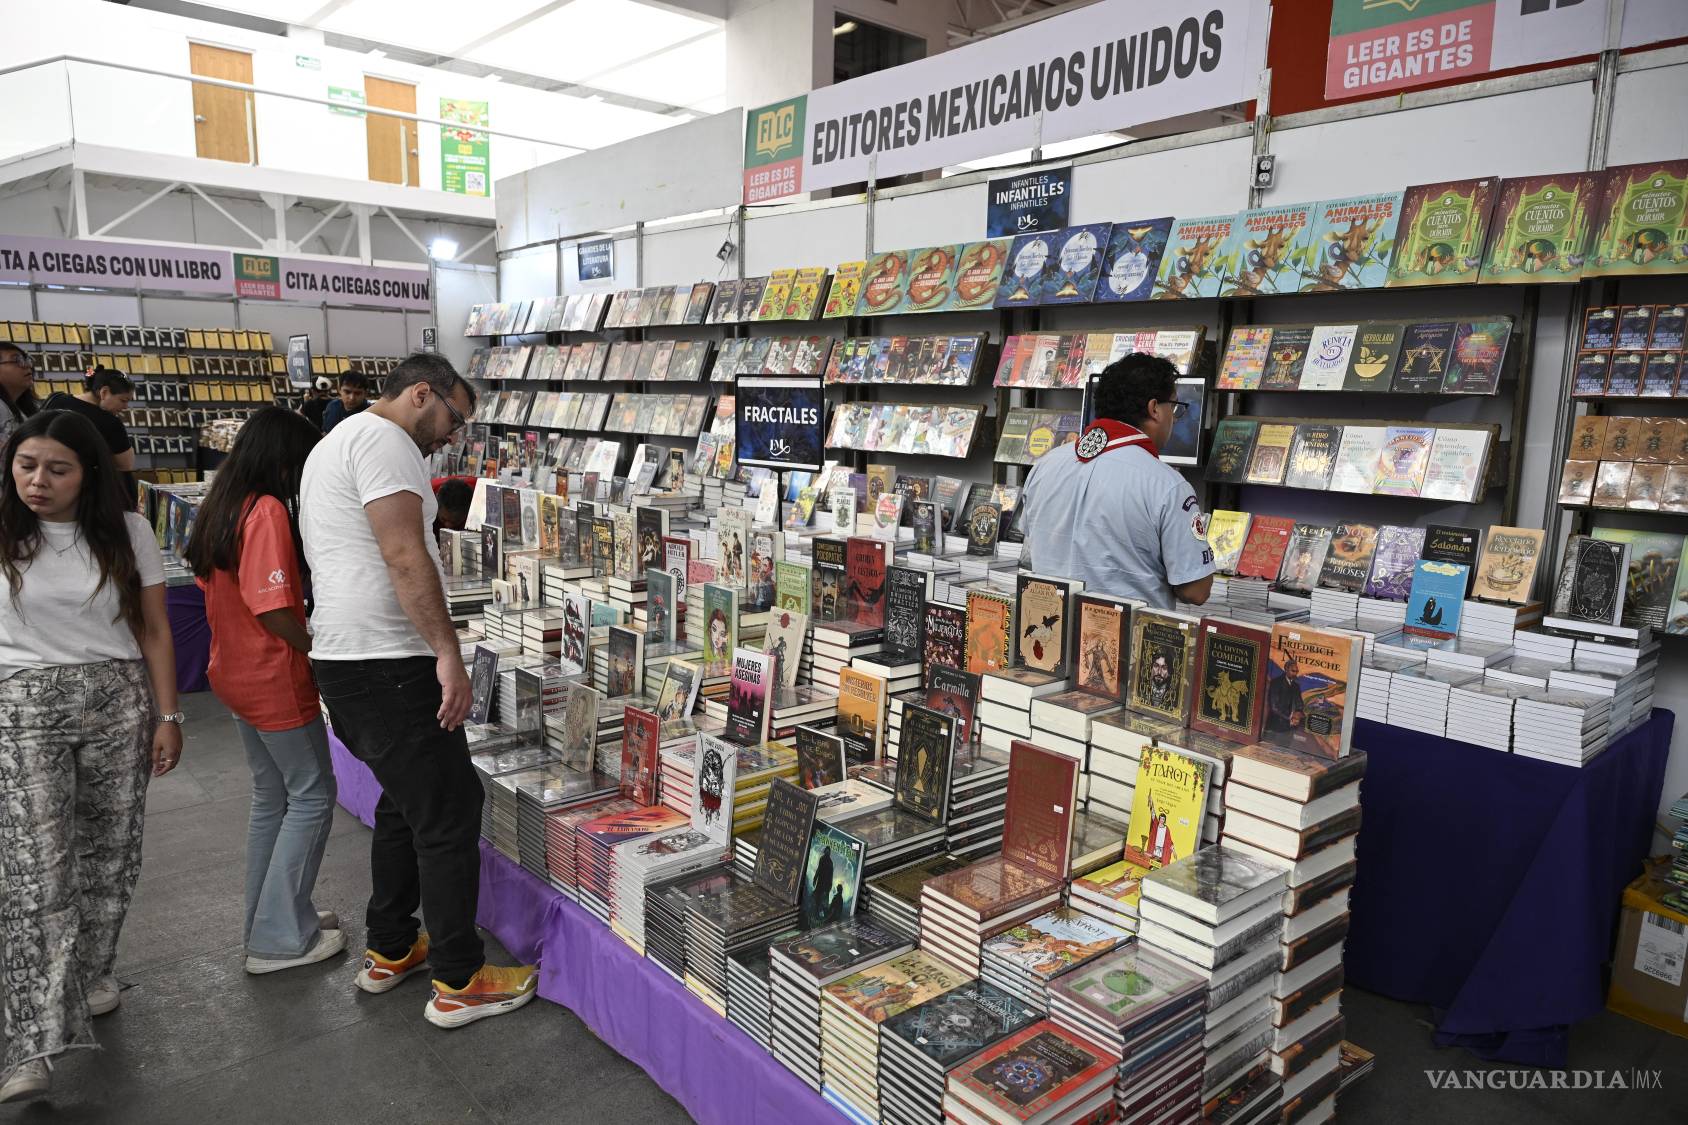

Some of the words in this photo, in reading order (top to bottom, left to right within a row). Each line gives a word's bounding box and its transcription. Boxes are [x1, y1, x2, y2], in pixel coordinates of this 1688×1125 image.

[1347, 36, 1401, 65] LEER
[1407, 28, 1434, 52] ES
[1439, 19, 1473, 46] DE
[1343, 44, 1473, 90] GIGANTES
[812, 98, 922, 165] EDITORES
[925, 51, 1085, 142] MEXICANOS
[1090, 9, 1224, 101] UNIDOS
[750, 170, 770, 186] LEER
[771, 168, 782, 181] ES
[784, 166, 795, 178] DE
[1012, 176, 1049, 189] INFANTILES
[1653, 179, 1664, 188] 5
[749, 180, 796, 201] GIGANTES
[996, 181, 1064, 205] INFANTILES
[1545, 191, 1554, 200] 5
[1010, 198, 1048, 211] INFANTILES
[1443, 197, 1453, 206] 5
[1632, 196, 1676, 211] CUENTOS
[1324, 202, 1393, 219] ANIMALES
[1329, 210, 1393, 224] ASQUEROSOS
[1525, 209, 1564, 221] CUENTOS
[1244, 212, 1306, 227] ANIMALES
[1250, 220, 1306, 232] ASQUEROSOS
[1426, 213, 1462, 226] CUENTOS
[1177, 223, 1231, 235] ANIMALES
[1180, 230, 1230, 240] ASQUEROSOS
[0, 249, 24, 271] TA
[28, 251, 40, 271] A
[43, 252, 107, 275] CIEGAS
[110, 256, 146, 277] CON
[149, 258, 172, 278] UN
[176, 260, 222, 280] LIBRO
[286, 271, 317, 290] CITA
[320, 274, 330, 291] A
[331, 275, 380, 296] CIEGAS
[382, 280, 409, 298] CON
[412, 283, 429, 300] UN
[744, 406, 818, 425] FRACTALES
[1300, 527, 1307, 535] 4
[1430, 539, 1471, 553] Salomón
[1333, 565, 1365, 578] DIOSES
[1214, 642, 1223, 650] LA
[1224, 645, 1249, 656] DIVINA
[1278, 634, 1335, 657] FRIEDRICH
[736, 657, 762, 673] MUJERES
[1211, 650, 1249, 666] COMEDIA
[1282, 648, 1341, 672] NIETZSCHE
[734, 670, 761, 685] ASESINAS
[934, 676, 970, 698] Carmilla
[1152, 763, 1192, 786] TAROT
[900, 959, 923, 968] EL
[922, 965, 952, 988] MAGO
[964, 989, 1023, 1025] NECRONOMICON
